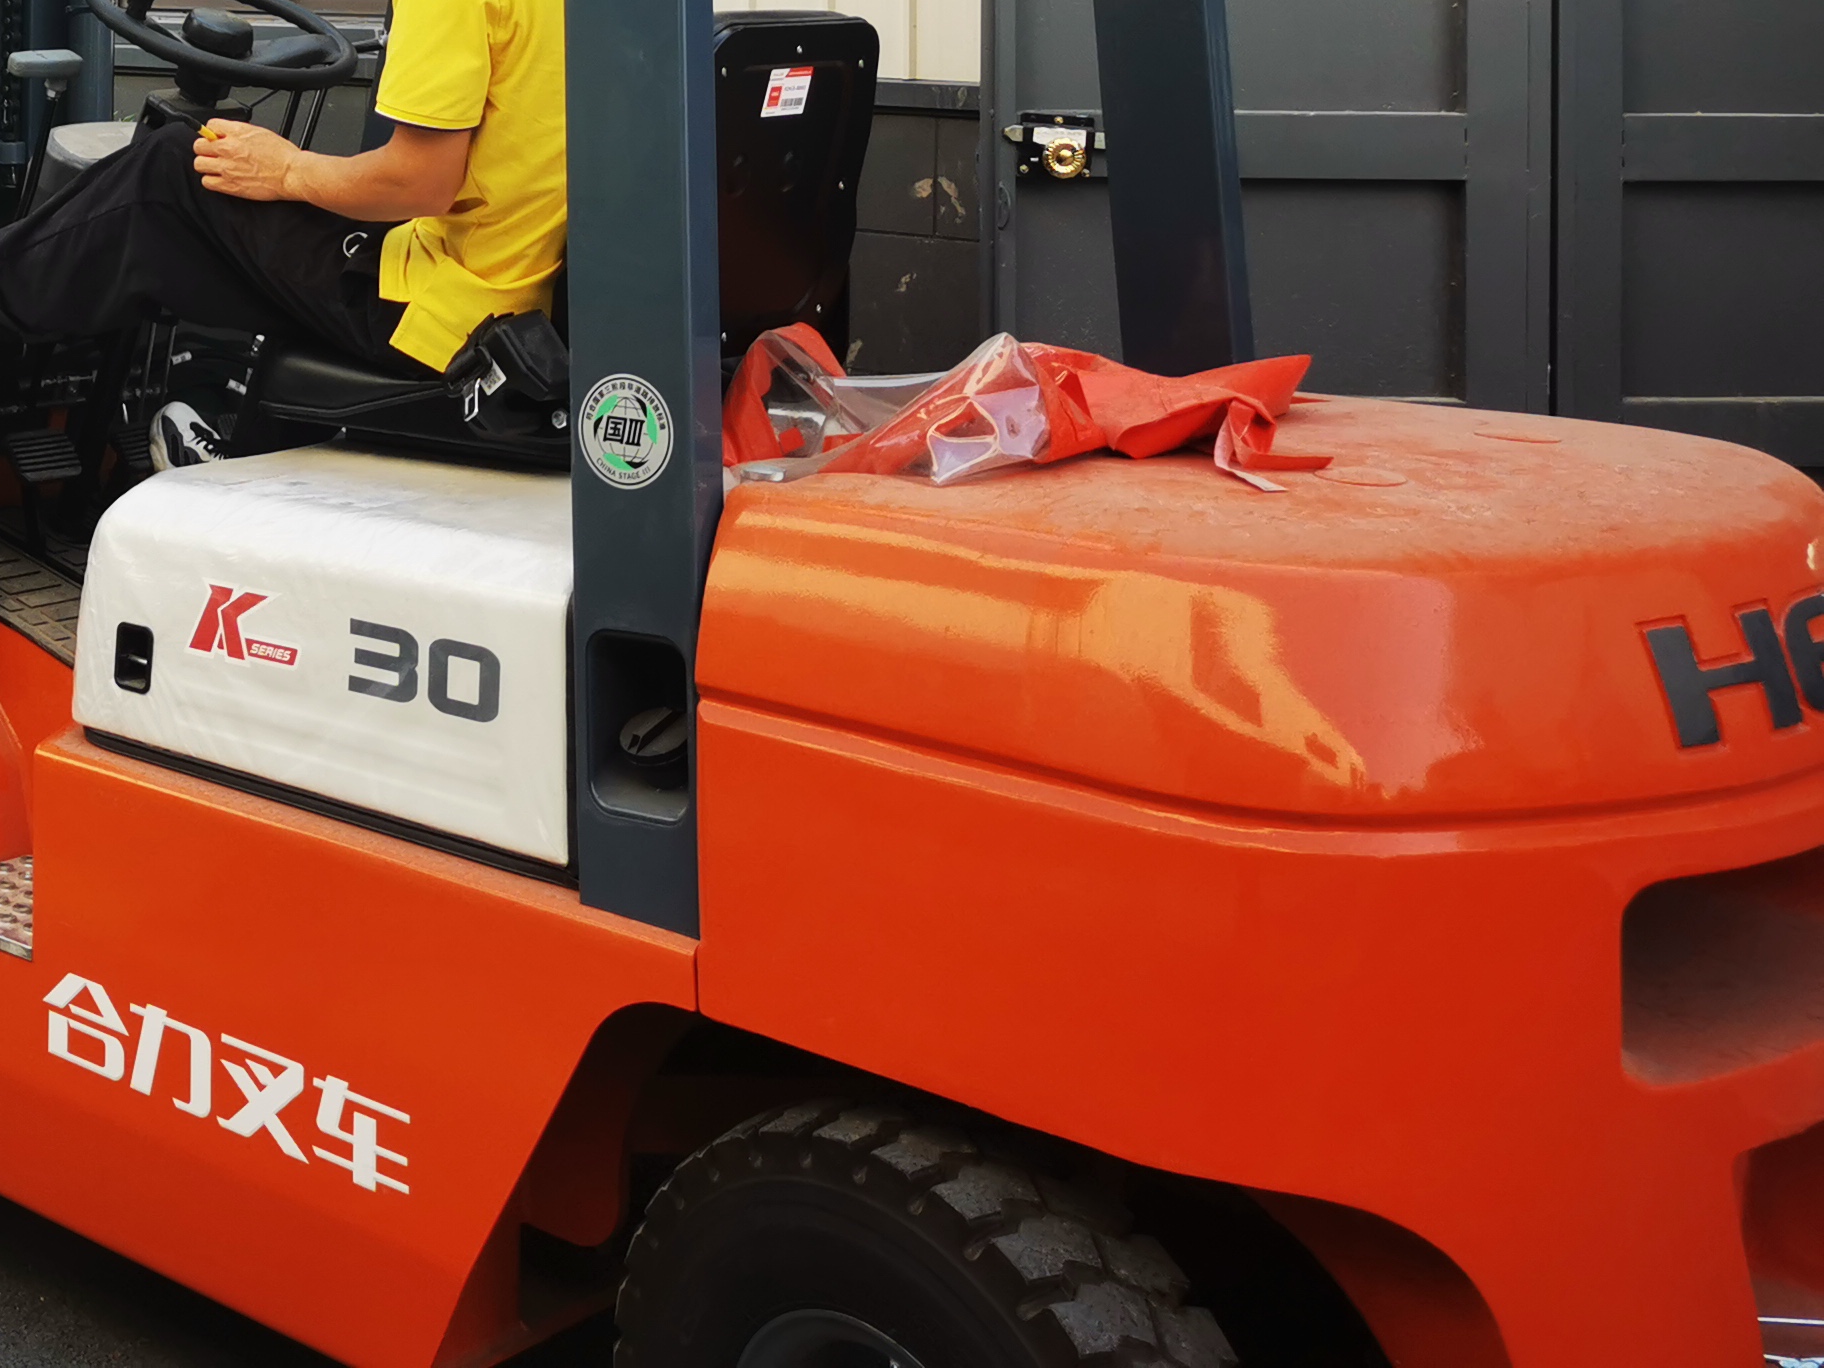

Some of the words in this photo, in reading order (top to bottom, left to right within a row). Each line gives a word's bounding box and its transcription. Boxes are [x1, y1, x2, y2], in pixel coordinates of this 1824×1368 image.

[596, 457, 616, 478] CHINA
[618, 471, 641, 481] STAGE
[189, 583, 268, 661] K
[250, 642, 292, 663] SERIES
[348, 617, 502, 723] 30
[42, 972, 411, 1195] 合力叉车
